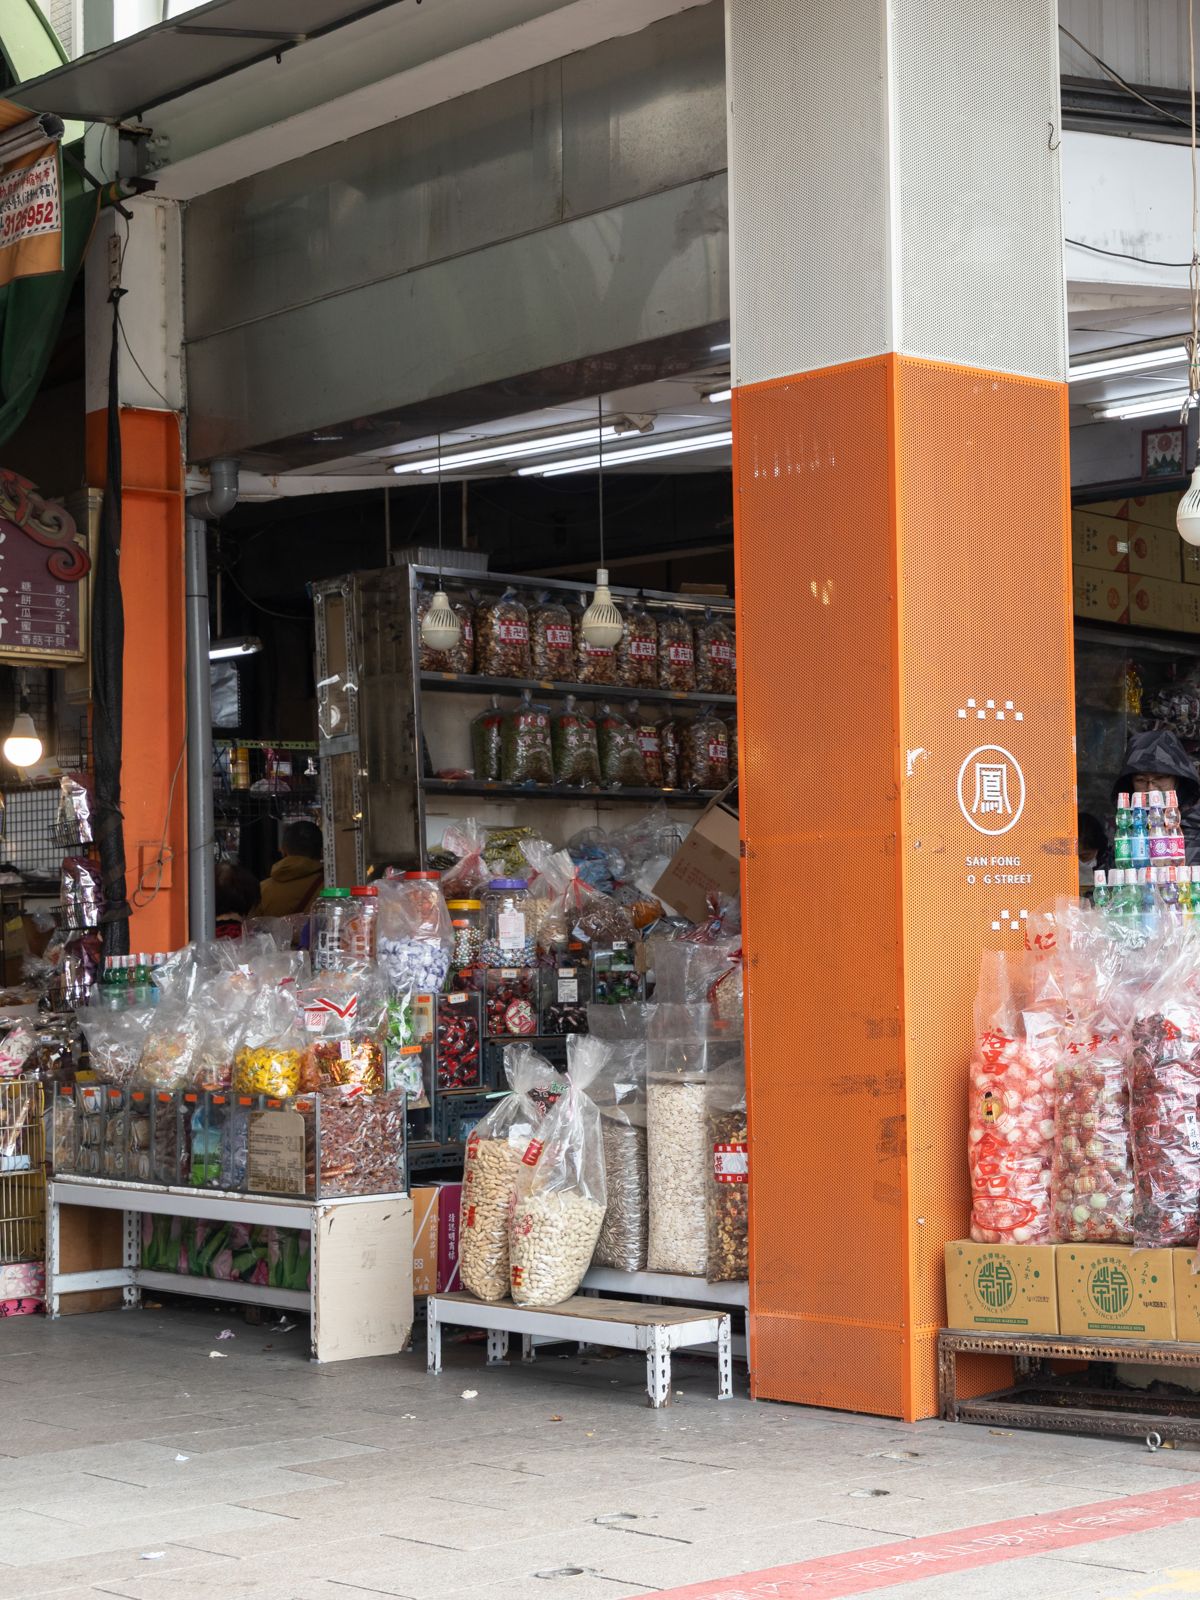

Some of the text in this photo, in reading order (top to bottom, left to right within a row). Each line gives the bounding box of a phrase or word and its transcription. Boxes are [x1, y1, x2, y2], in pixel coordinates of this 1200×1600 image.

[4, 201, 54, 237] 3126952
[22, 635, 65, 647] 香菇干貝
[971, 763, 1012, 814] 鳳
[966, 856, 1020, 866] SAN FONG
[994, 874, 1032, 884] STREET
[508, 1013, 532, 1034] 150
